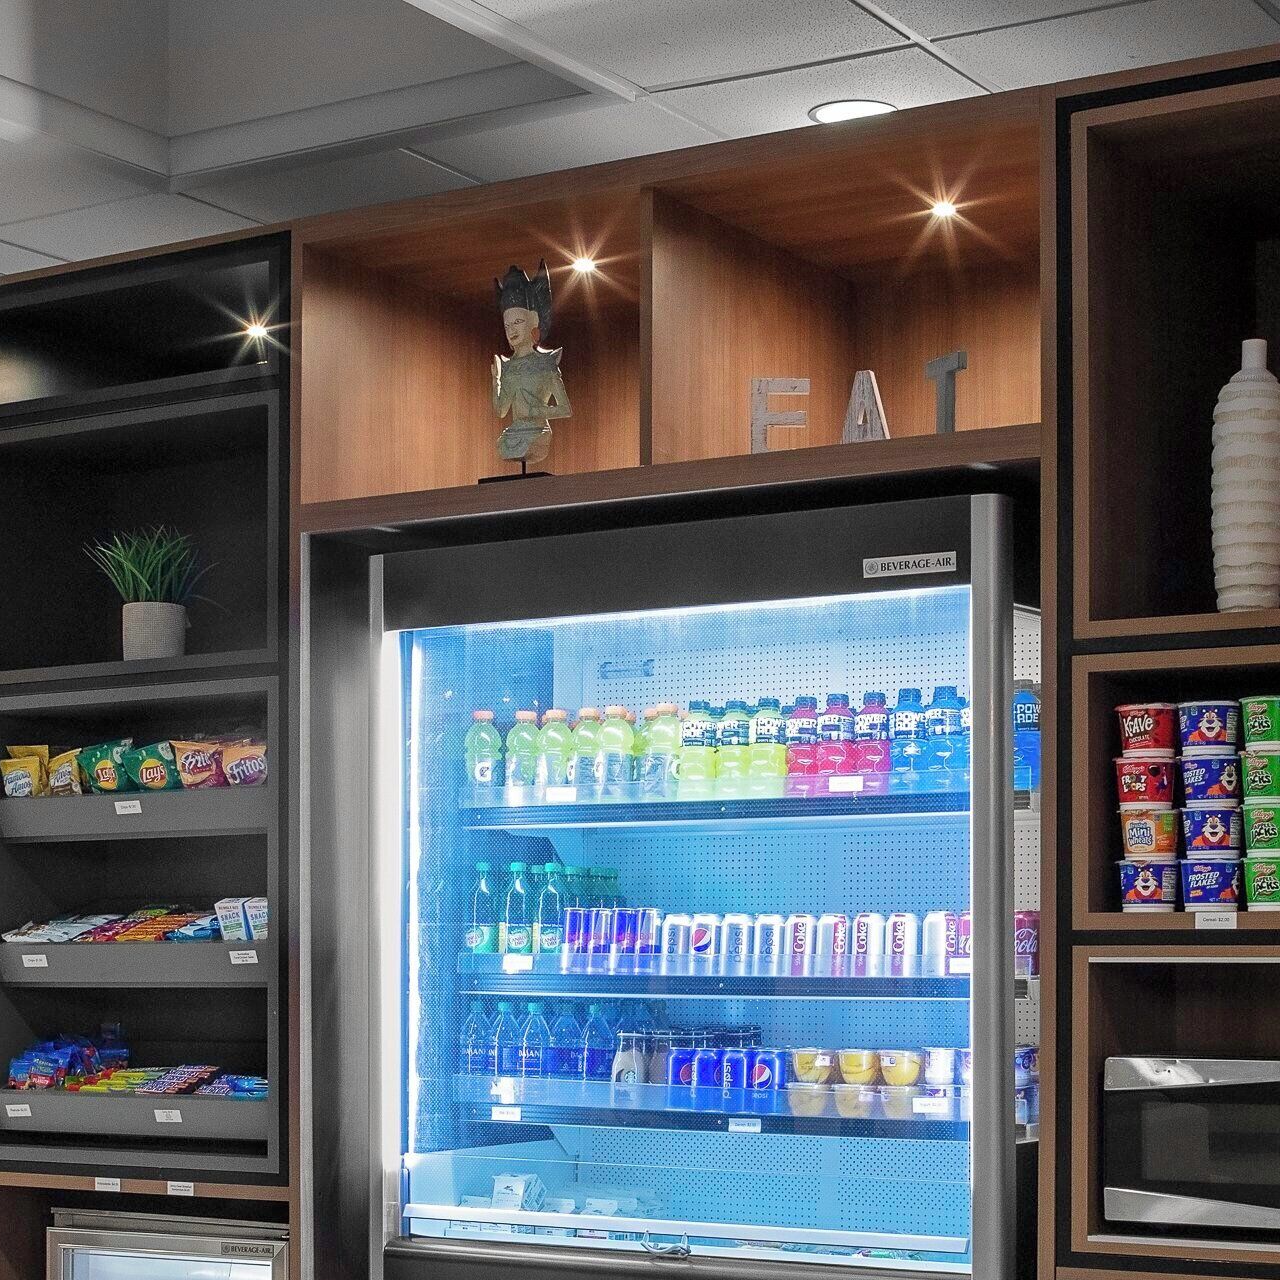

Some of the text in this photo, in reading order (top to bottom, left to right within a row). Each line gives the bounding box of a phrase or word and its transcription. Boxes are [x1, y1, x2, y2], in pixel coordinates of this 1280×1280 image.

[751, 351, 968, 454] EAT
[880, 557, 952, 572] BEVERAGE-AIR
[1016, 713, 1039, 723] ADE
[227, 754, 265, 783] Fritos
[1129, 827, 1151, 838] Mini
[1188, 871, 1220, 882] FROSTED
[1190, 879, 1216, 888] FLAKES
[220, 912, 240, 922] SNACK
[666, 927, 677, 963] pepsi
[793, 921, 805, 952] Coke
[833, 921, 846, 953] Coke
[856, 921, 868, 953] Coke
[892, 921, 905, 952] Coke
[722, 1062, 733, 1099] pepsi
